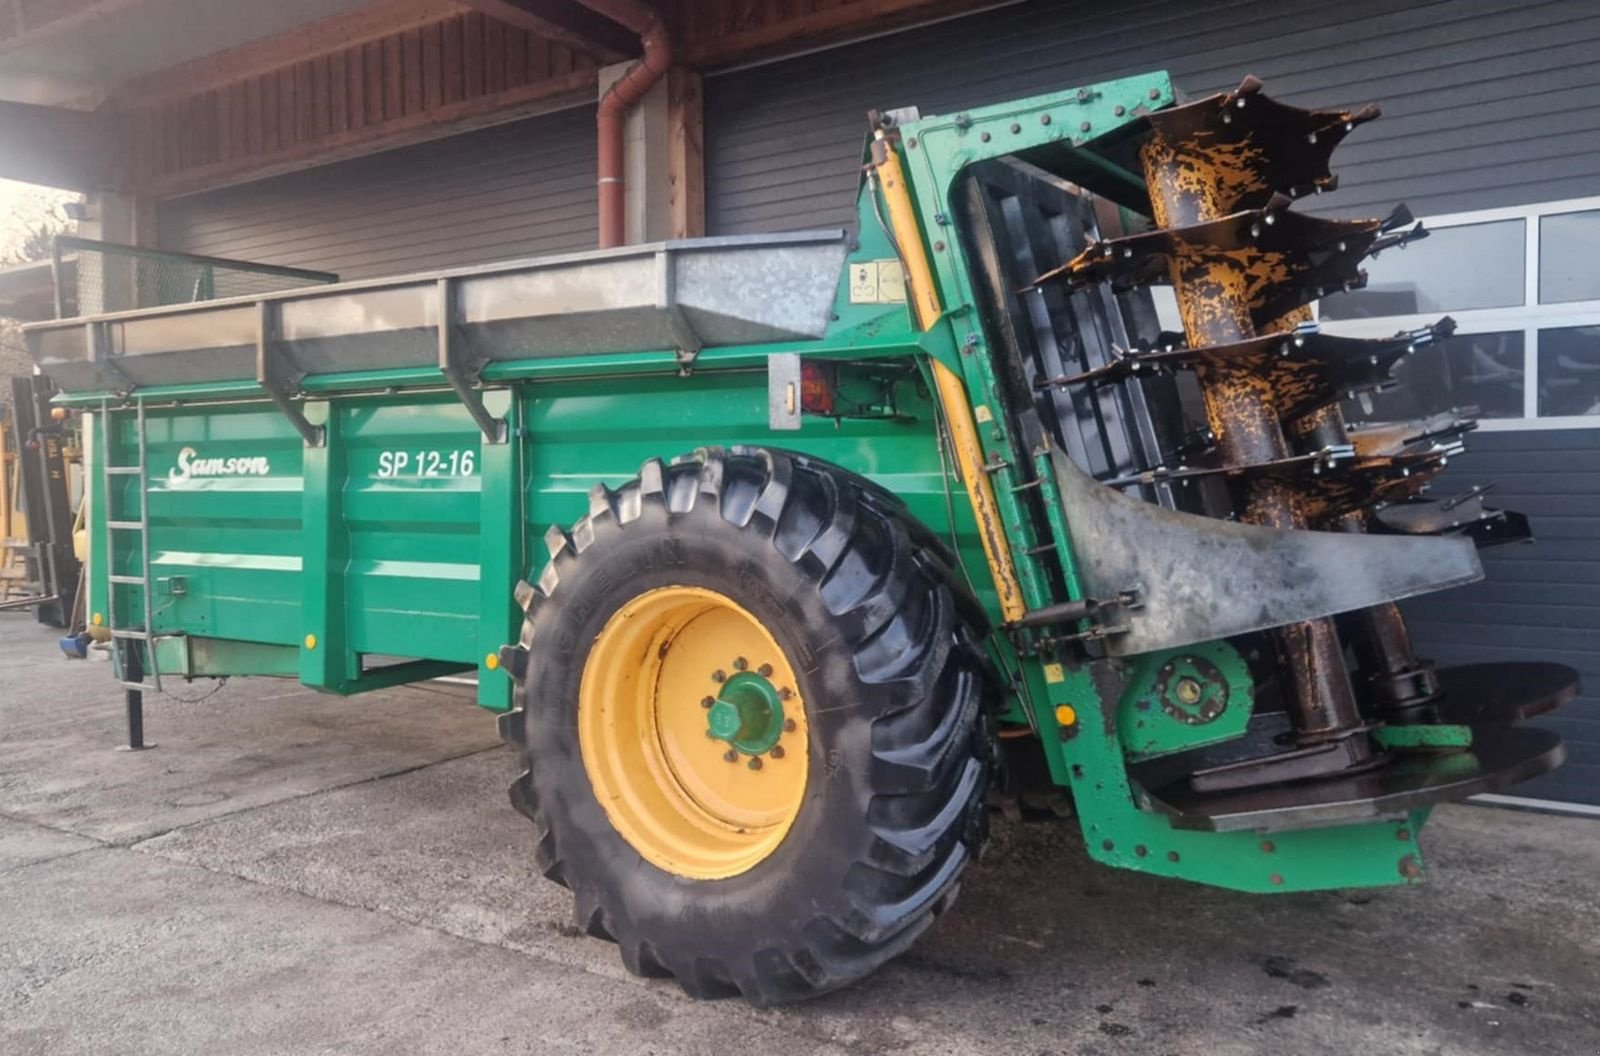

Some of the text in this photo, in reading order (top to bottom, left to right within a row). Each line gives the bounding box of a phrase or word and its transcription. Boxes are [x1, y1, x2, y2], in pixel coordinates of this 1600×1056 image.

[169, 447, 269, 483] Samson
[378, 450, 474, 476] SP 12-16
